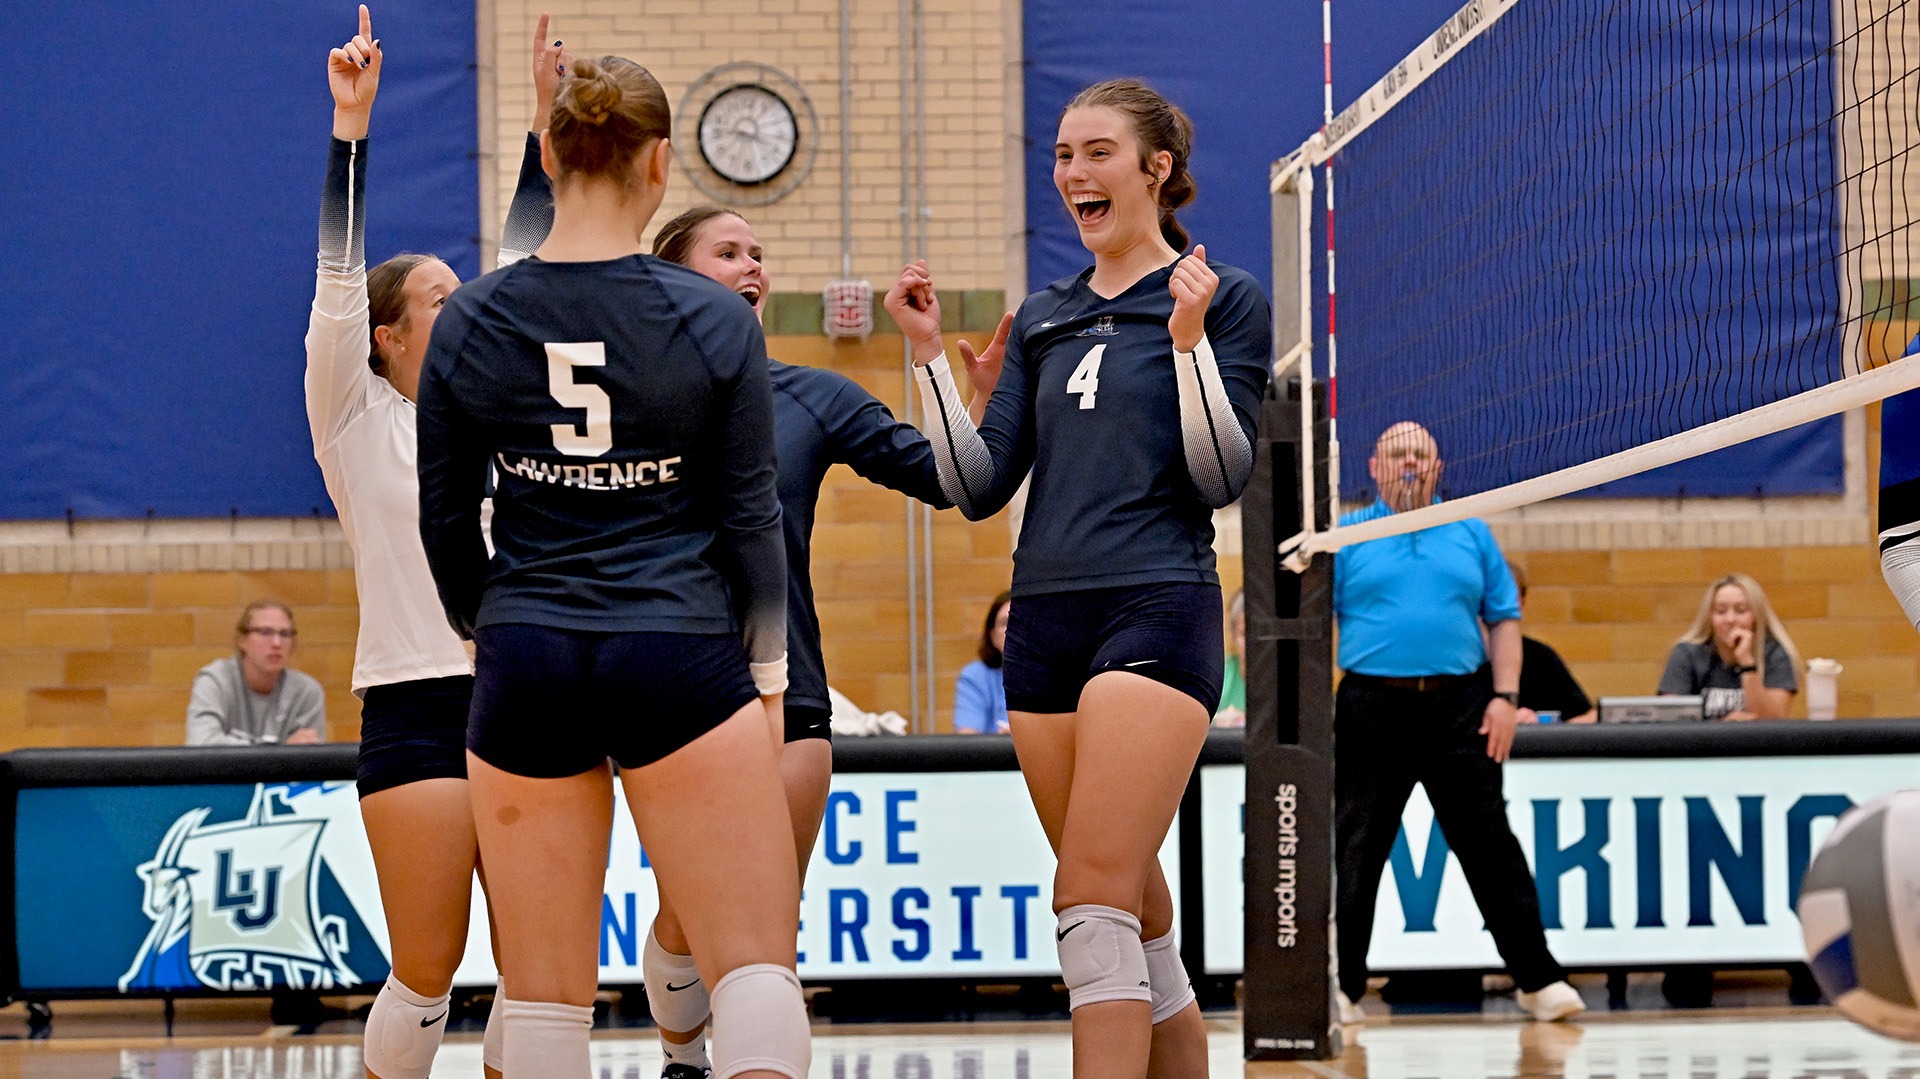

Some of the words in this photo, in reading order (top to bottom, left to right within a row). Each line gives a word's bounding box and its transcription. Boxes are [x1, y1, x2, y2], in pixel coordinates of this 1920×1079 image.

[544, 341, 613, 457] 5
[1066, 343, 1107, 410] 4
[498, 452, 681, 490] LAWRENCE
[1274, 784, 1299, 856] sports
[214, 848, 282, 931] LU
[1273, 858, 1299, 948] imports
